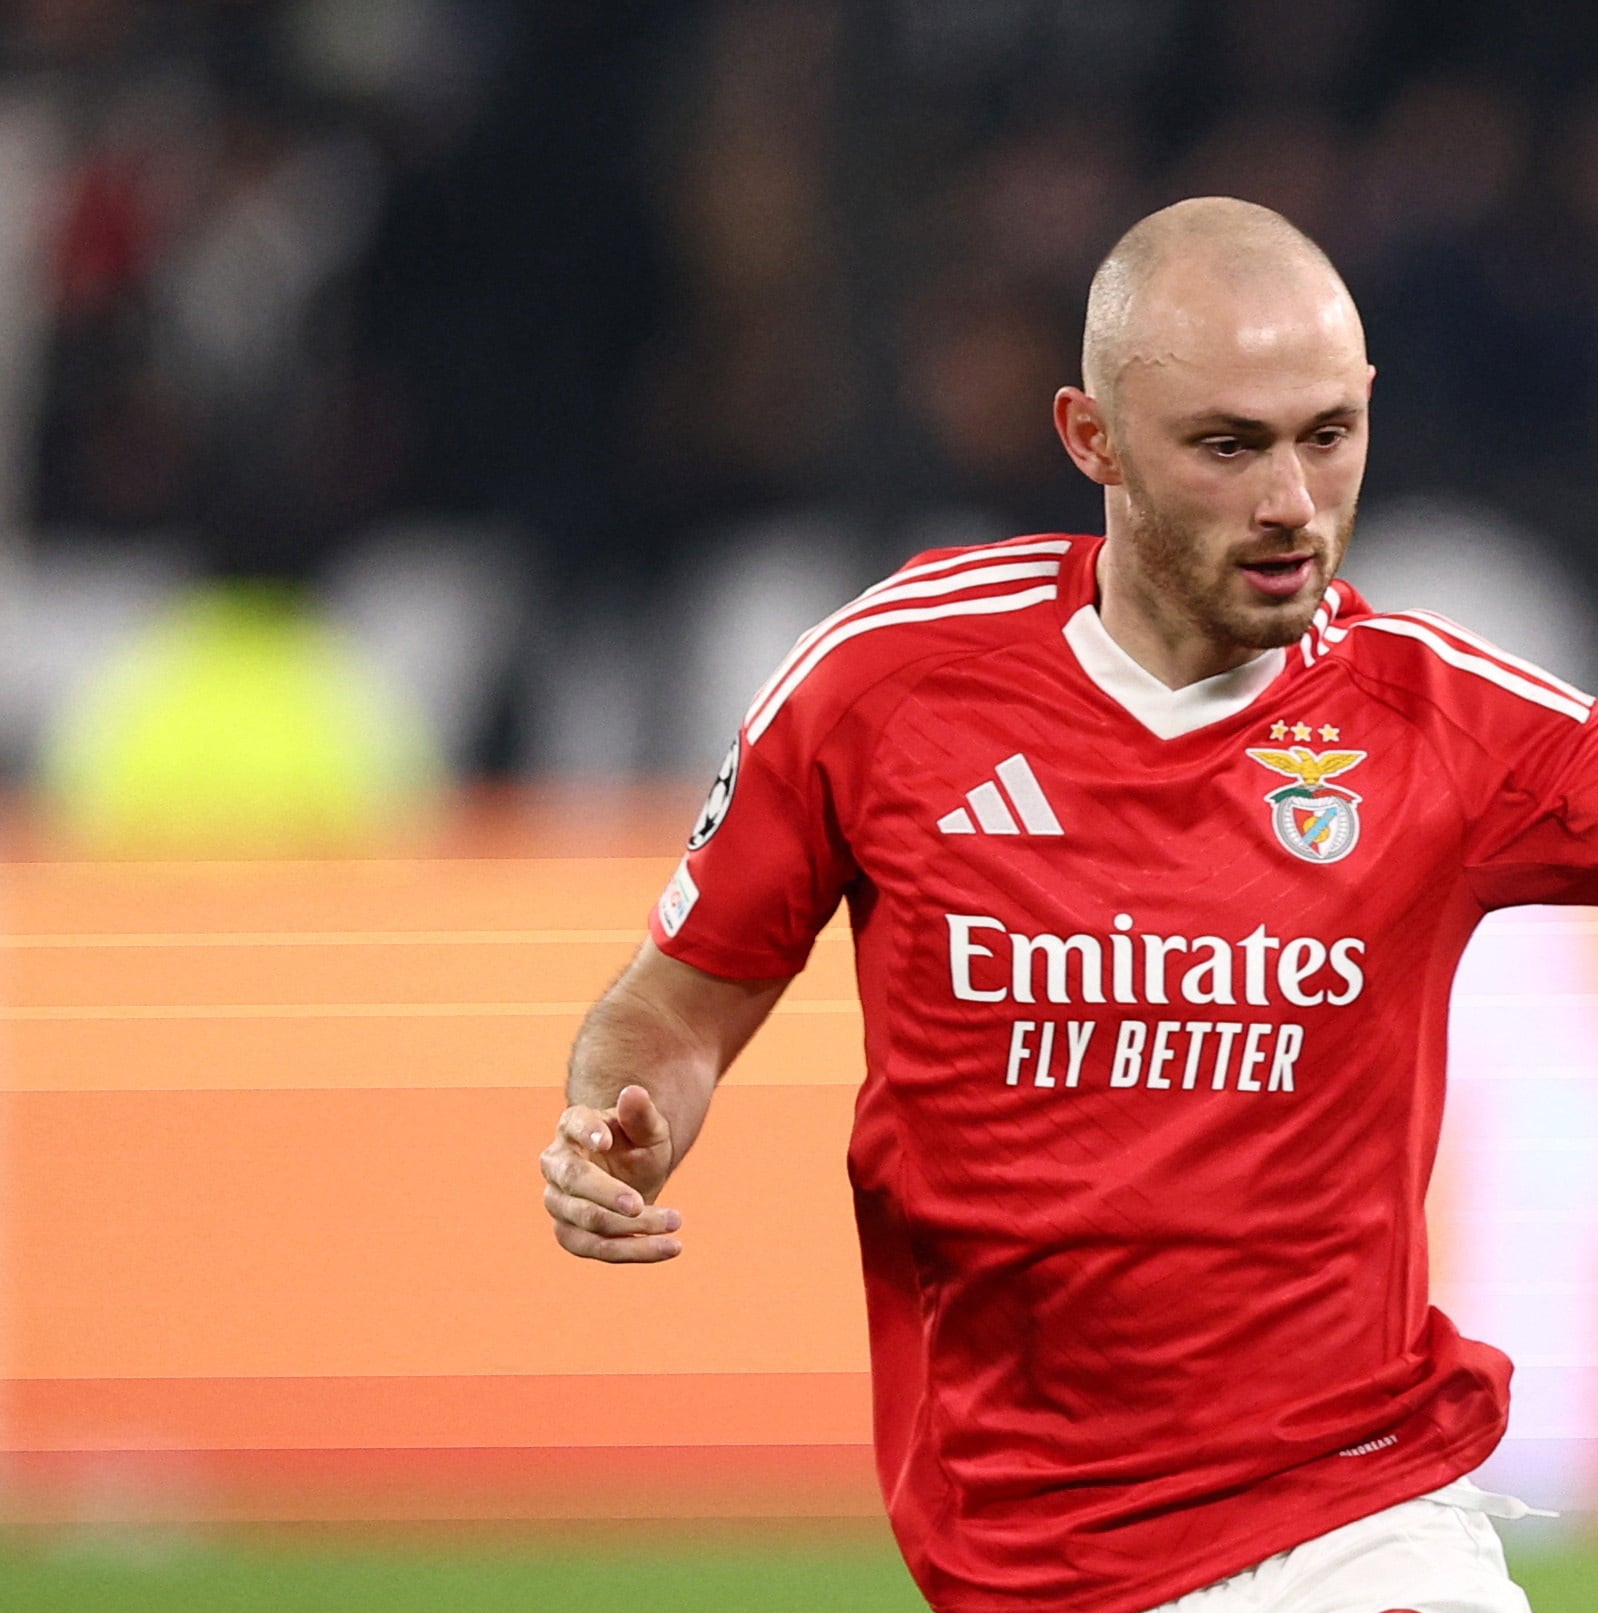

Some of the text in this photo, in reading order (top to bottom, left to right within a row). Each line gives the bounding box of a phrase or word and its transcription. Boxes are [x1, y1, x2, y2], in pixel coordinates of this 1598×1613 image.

[944, 913, 1366, 1007] Emirates
[1006, 1020, 1304, 1092] FLY BETTER
